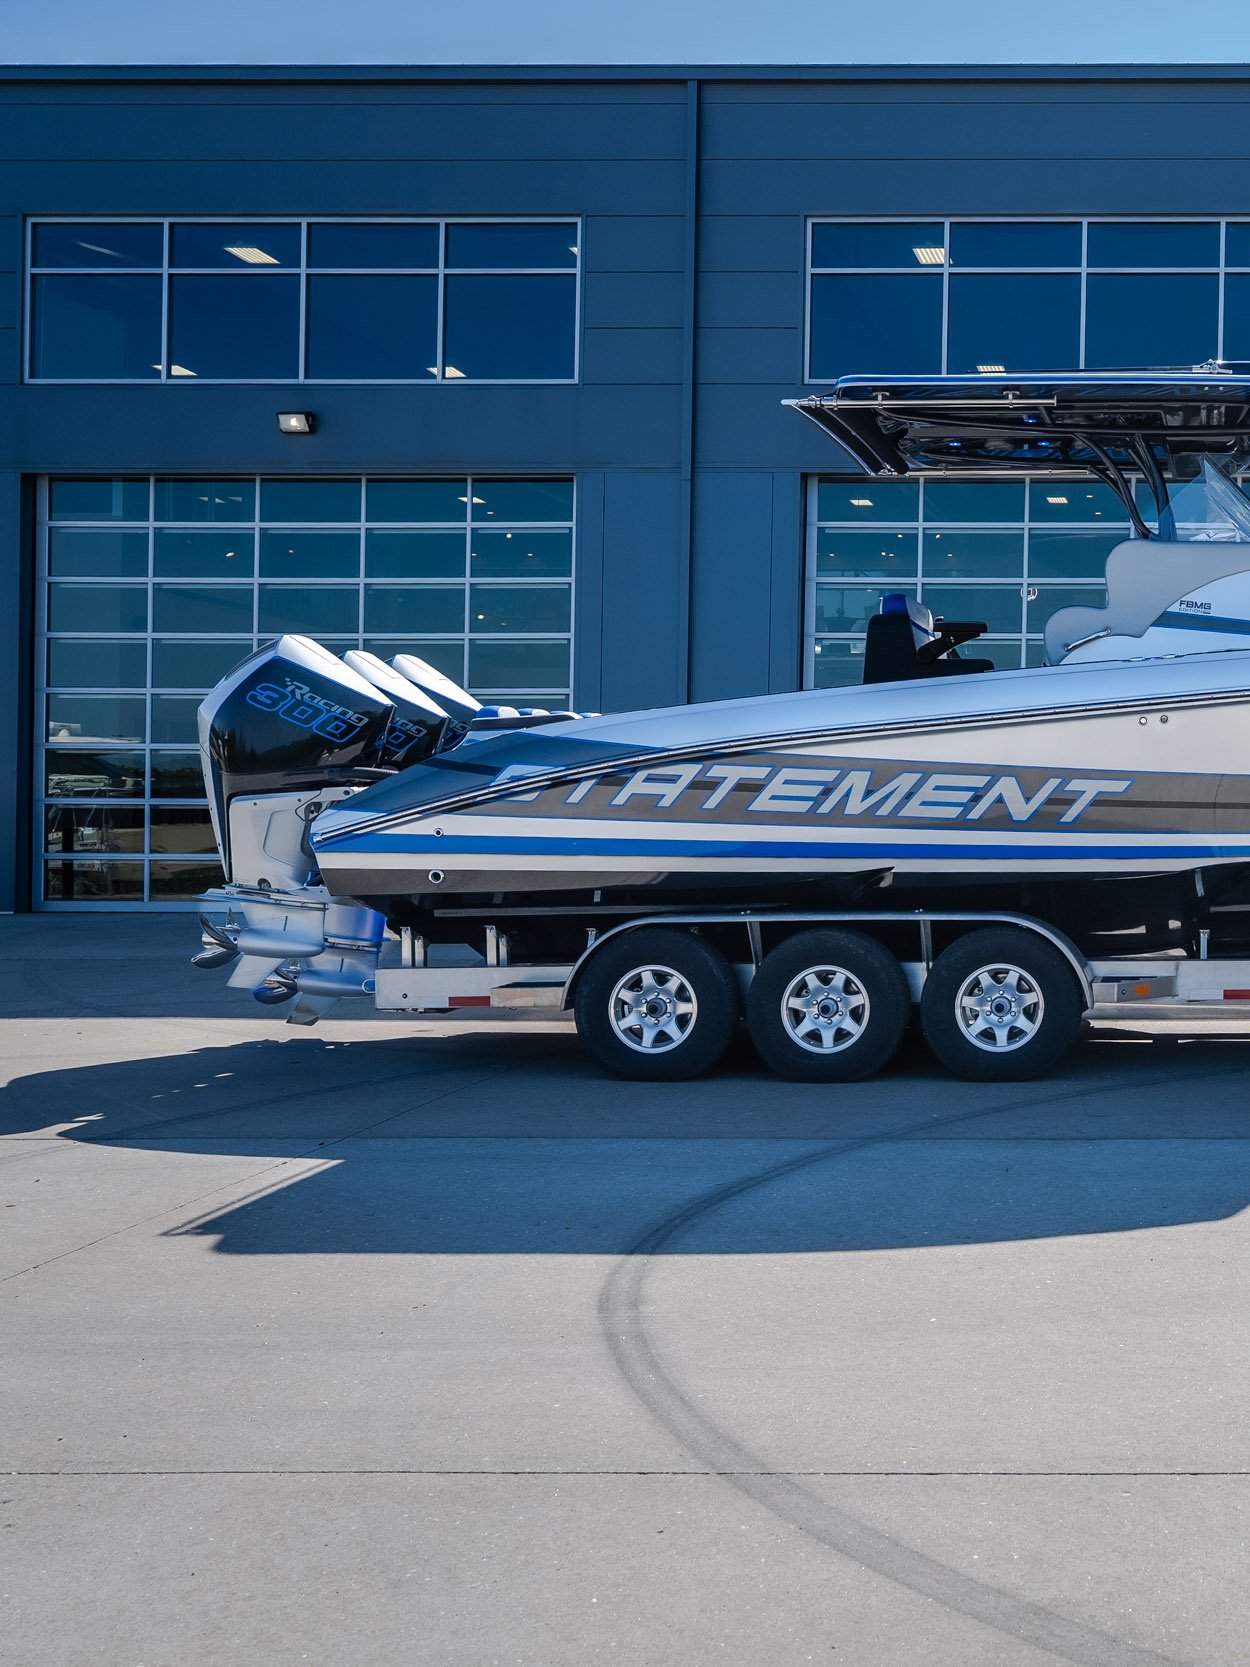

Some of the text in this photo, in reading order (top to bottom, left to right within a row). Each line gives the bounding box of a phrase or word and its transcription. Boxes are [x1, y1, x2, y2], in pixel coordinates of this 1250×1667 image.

[1179, 600, 1212, 610] FBMG
[246, 682, 361, 743] 300
[285, 677, 369, 727] Racing
